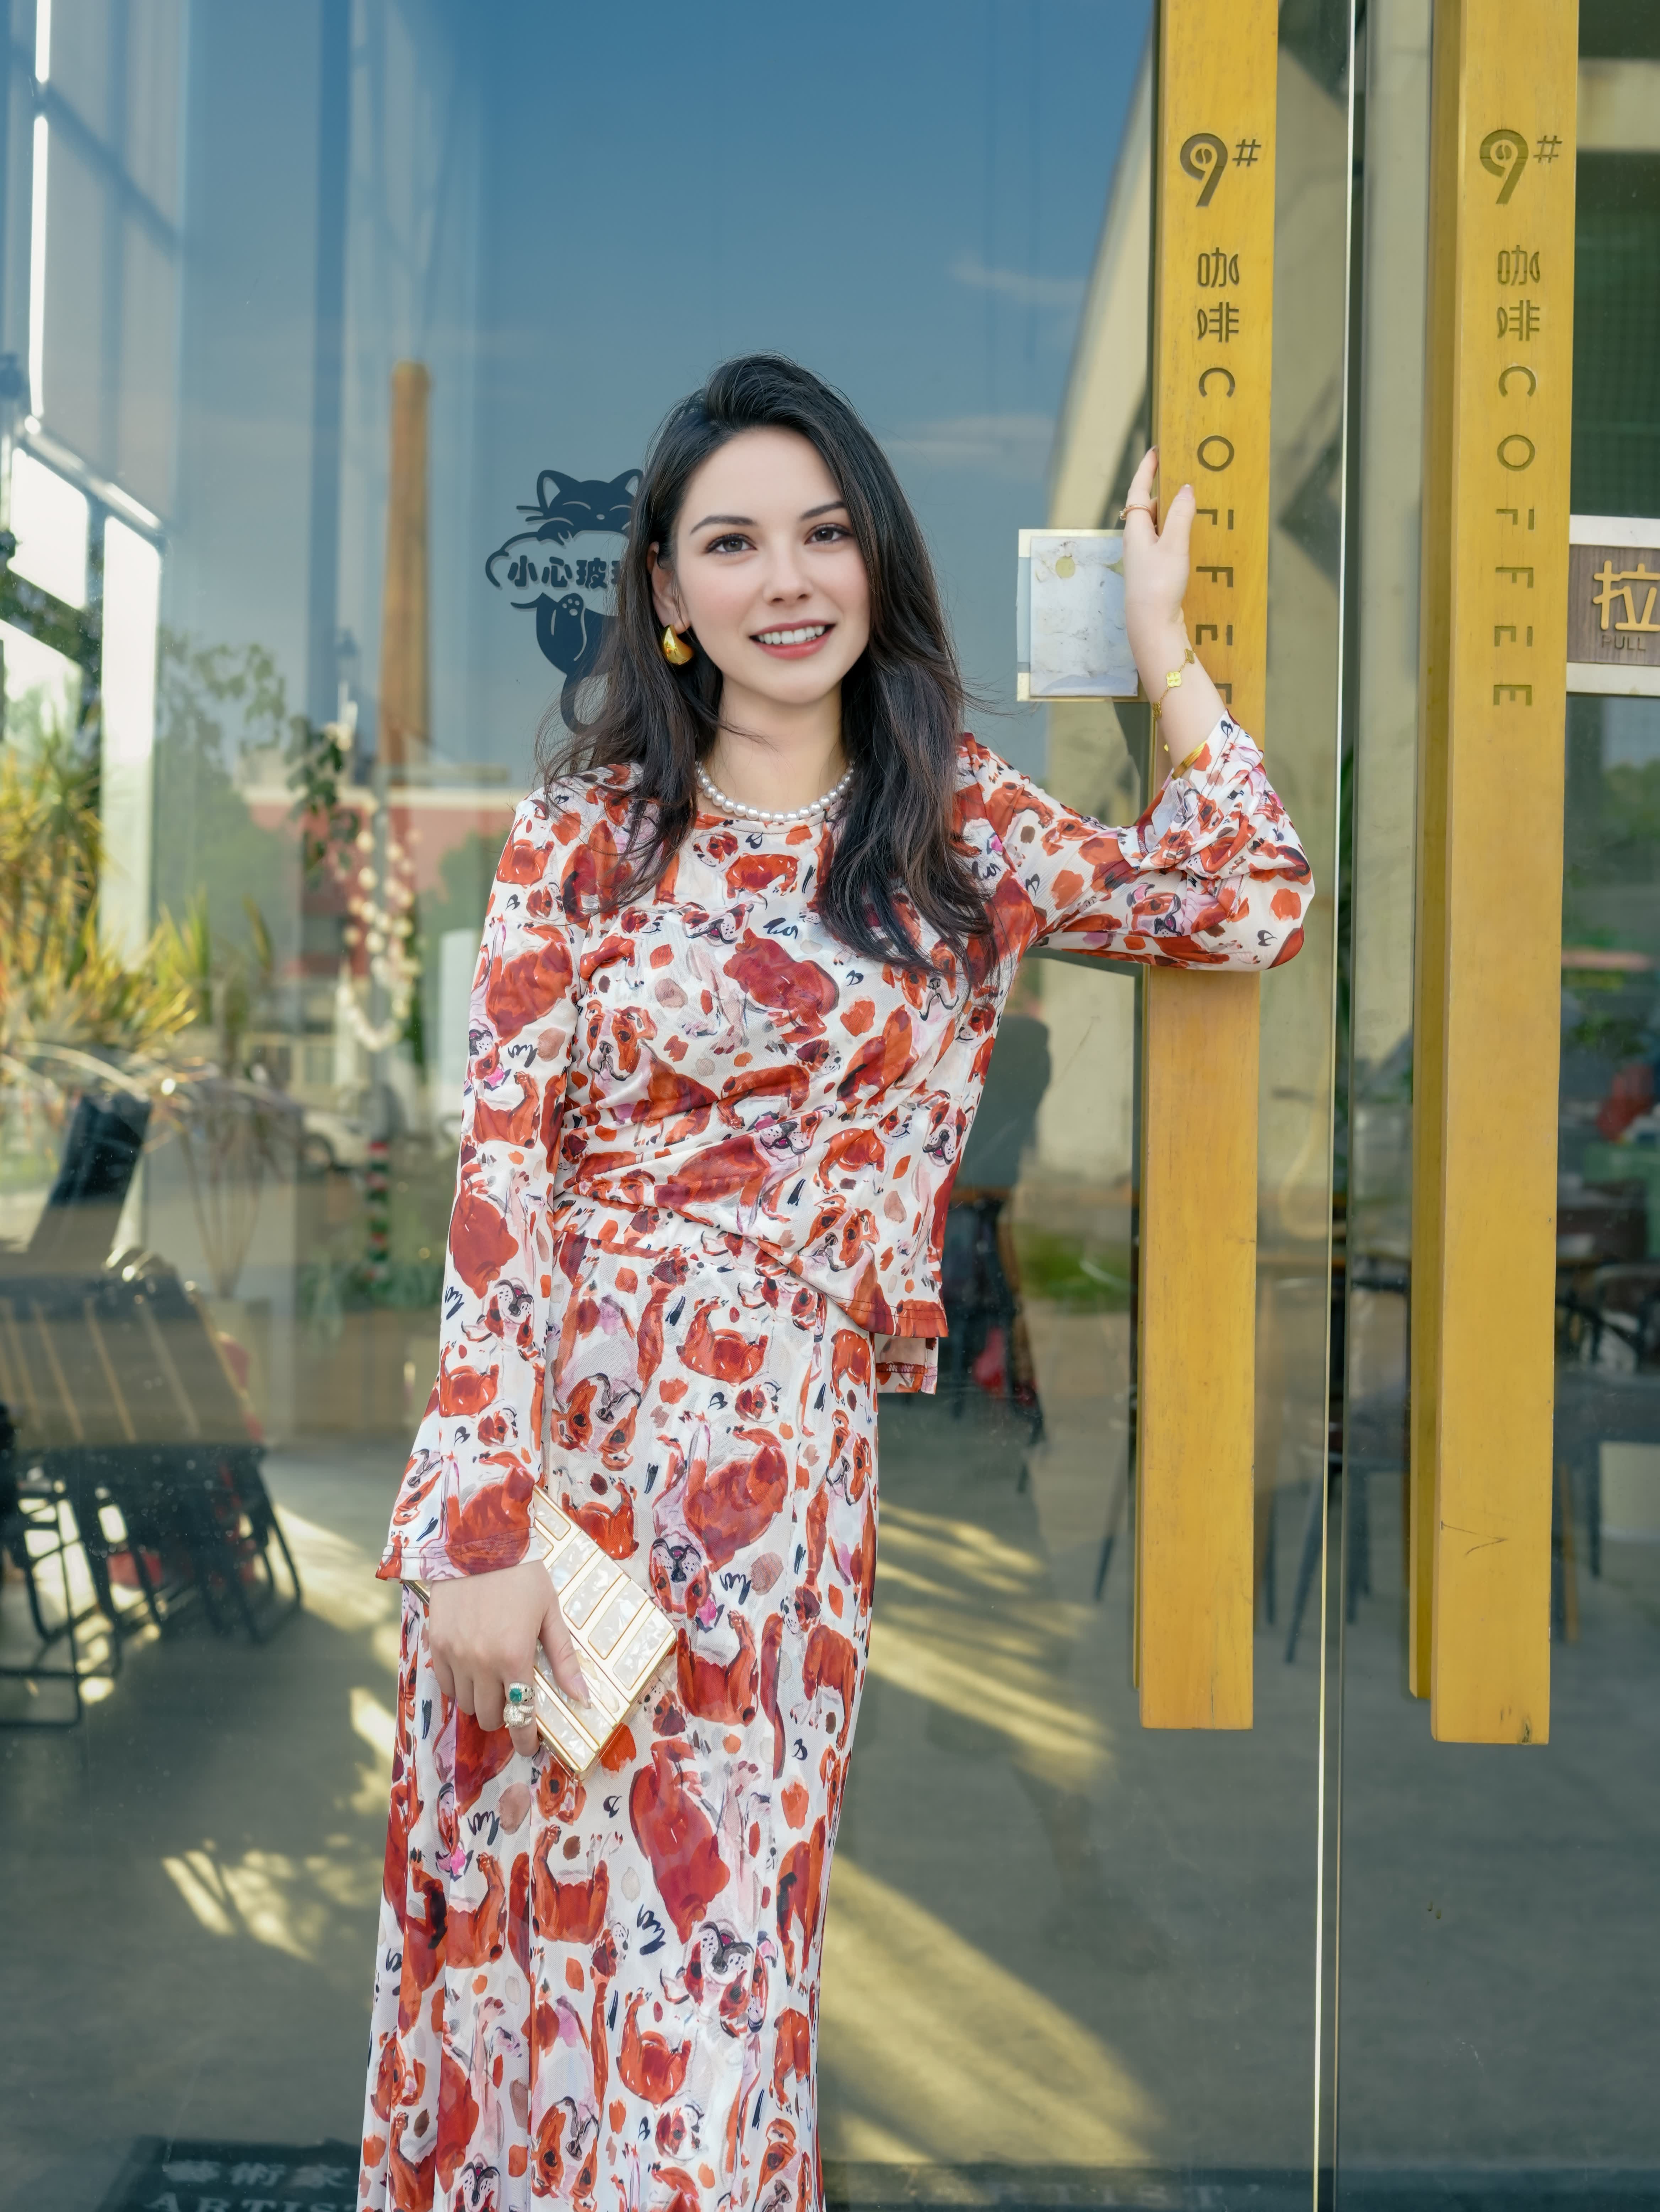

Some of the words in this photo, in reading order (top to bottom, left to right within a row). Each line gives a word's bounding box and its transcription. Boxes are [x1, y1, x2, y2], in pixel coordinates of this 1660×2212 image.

[1197, 247, 1240, 343] 咖啡
[1497, 245, 1541, 342] 咖啡
[1493, 366, 1536, 706] COFFEE
[1592, 560, 1660, 632] 拉
[1601, 634, 1646, 652] PULL
